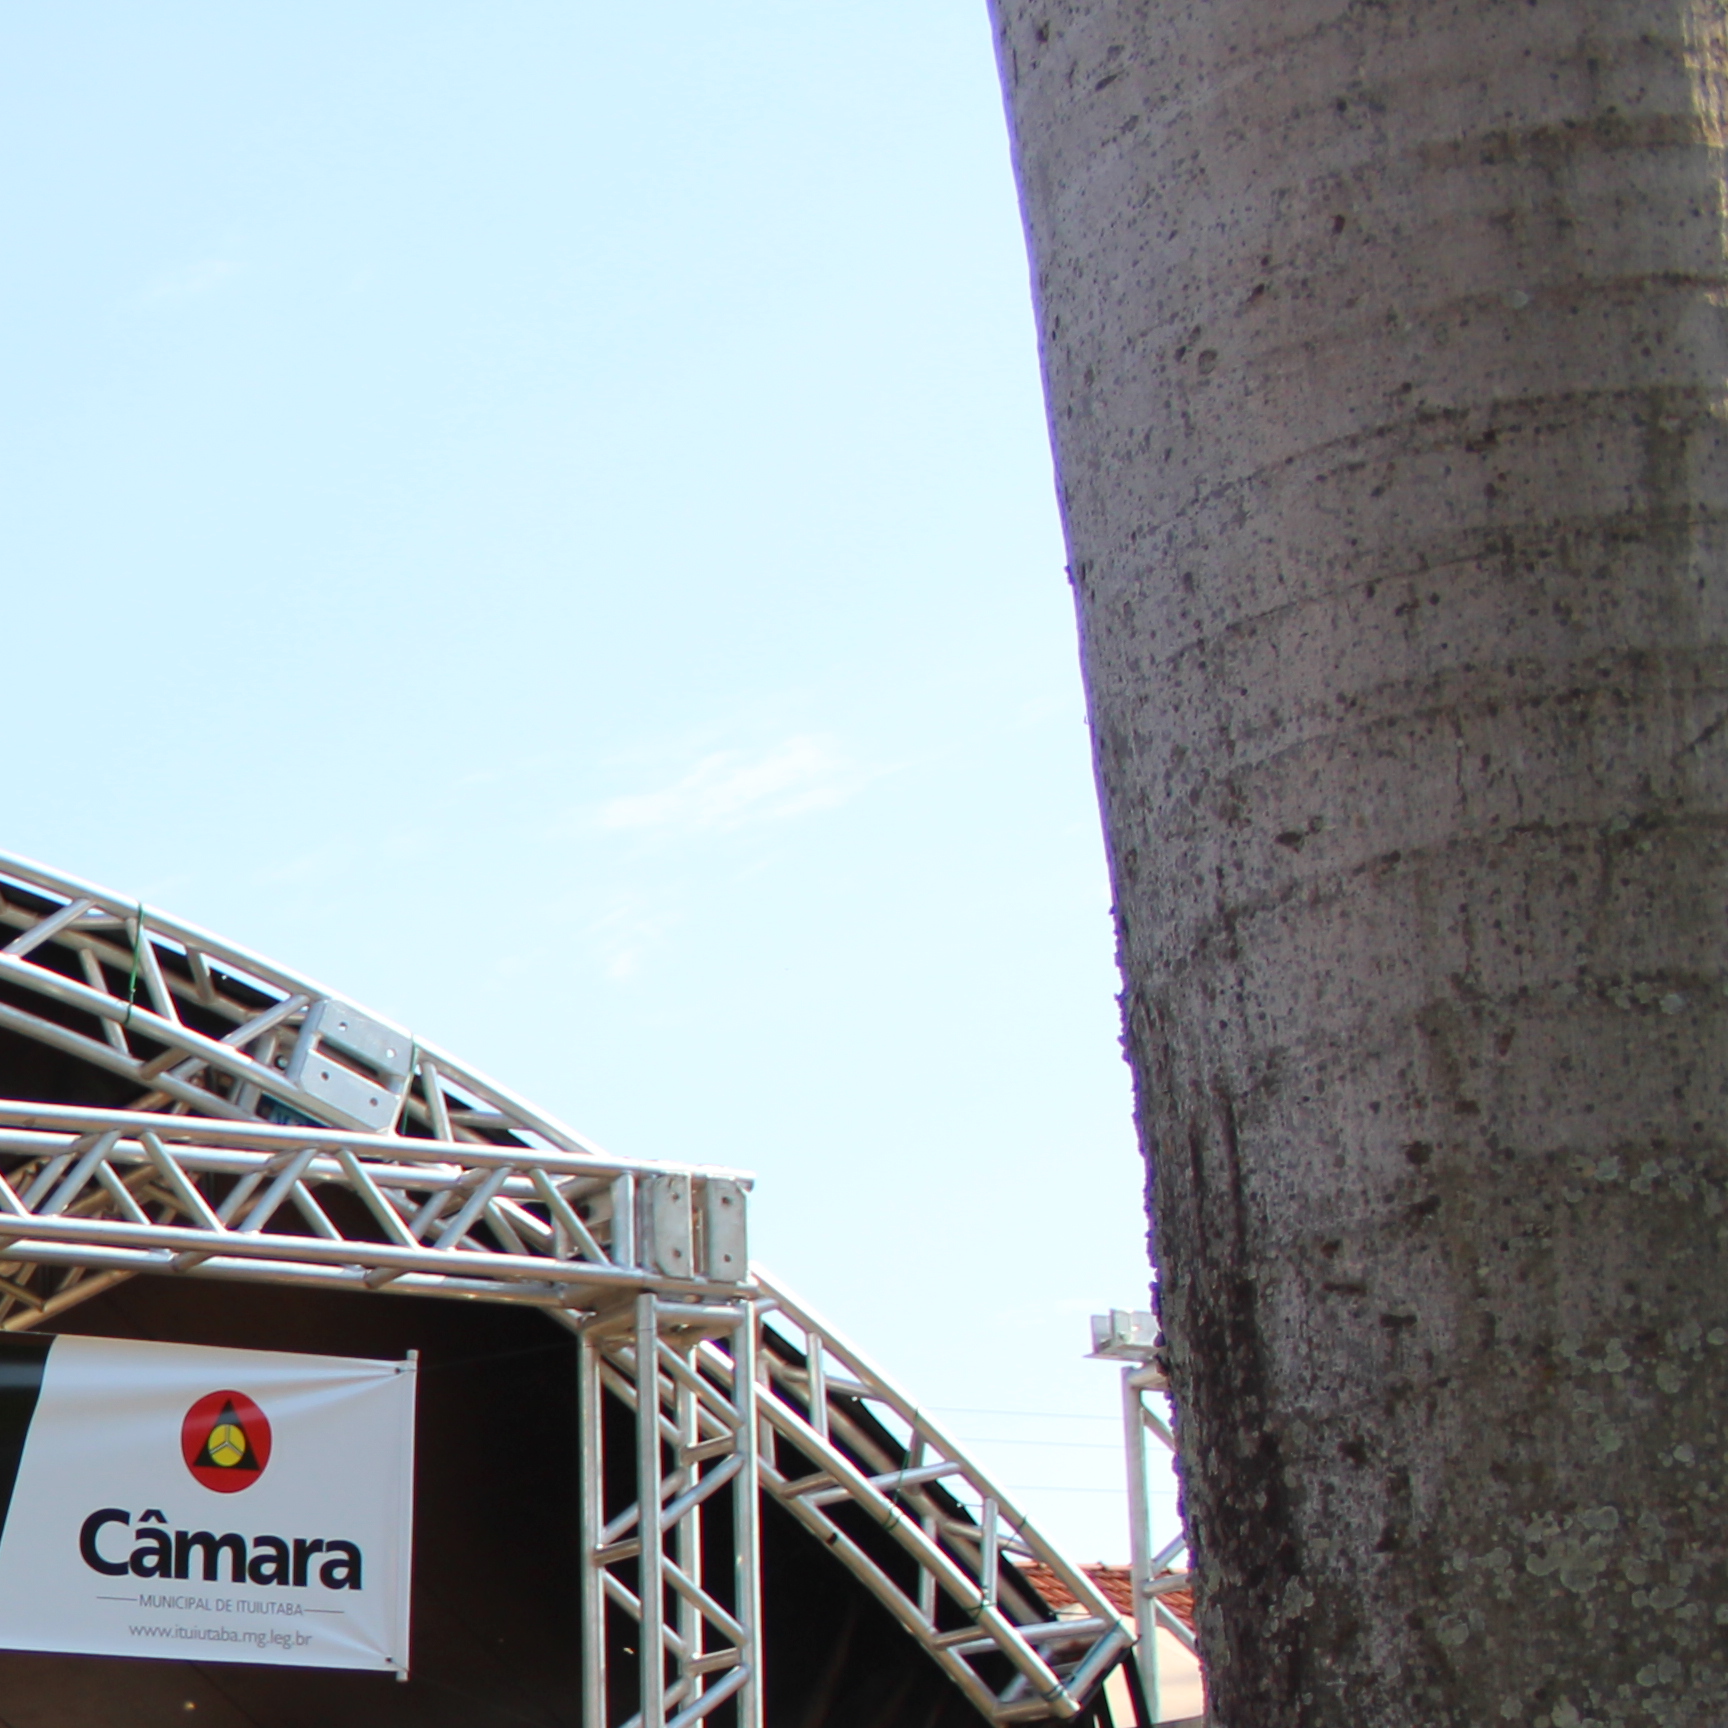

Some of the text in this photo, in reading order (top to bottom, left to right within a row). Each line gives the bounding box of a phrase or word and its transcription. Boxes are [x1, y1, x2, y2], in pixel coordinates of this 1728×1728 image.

[79, 1507, 363, 1591] Câmara
[139, 1594, 304, 1616] MUNICIPAL DE ITUIUTABA
[128, 1622, 313, 1650] www.ituiutaba.mg.leg.br
